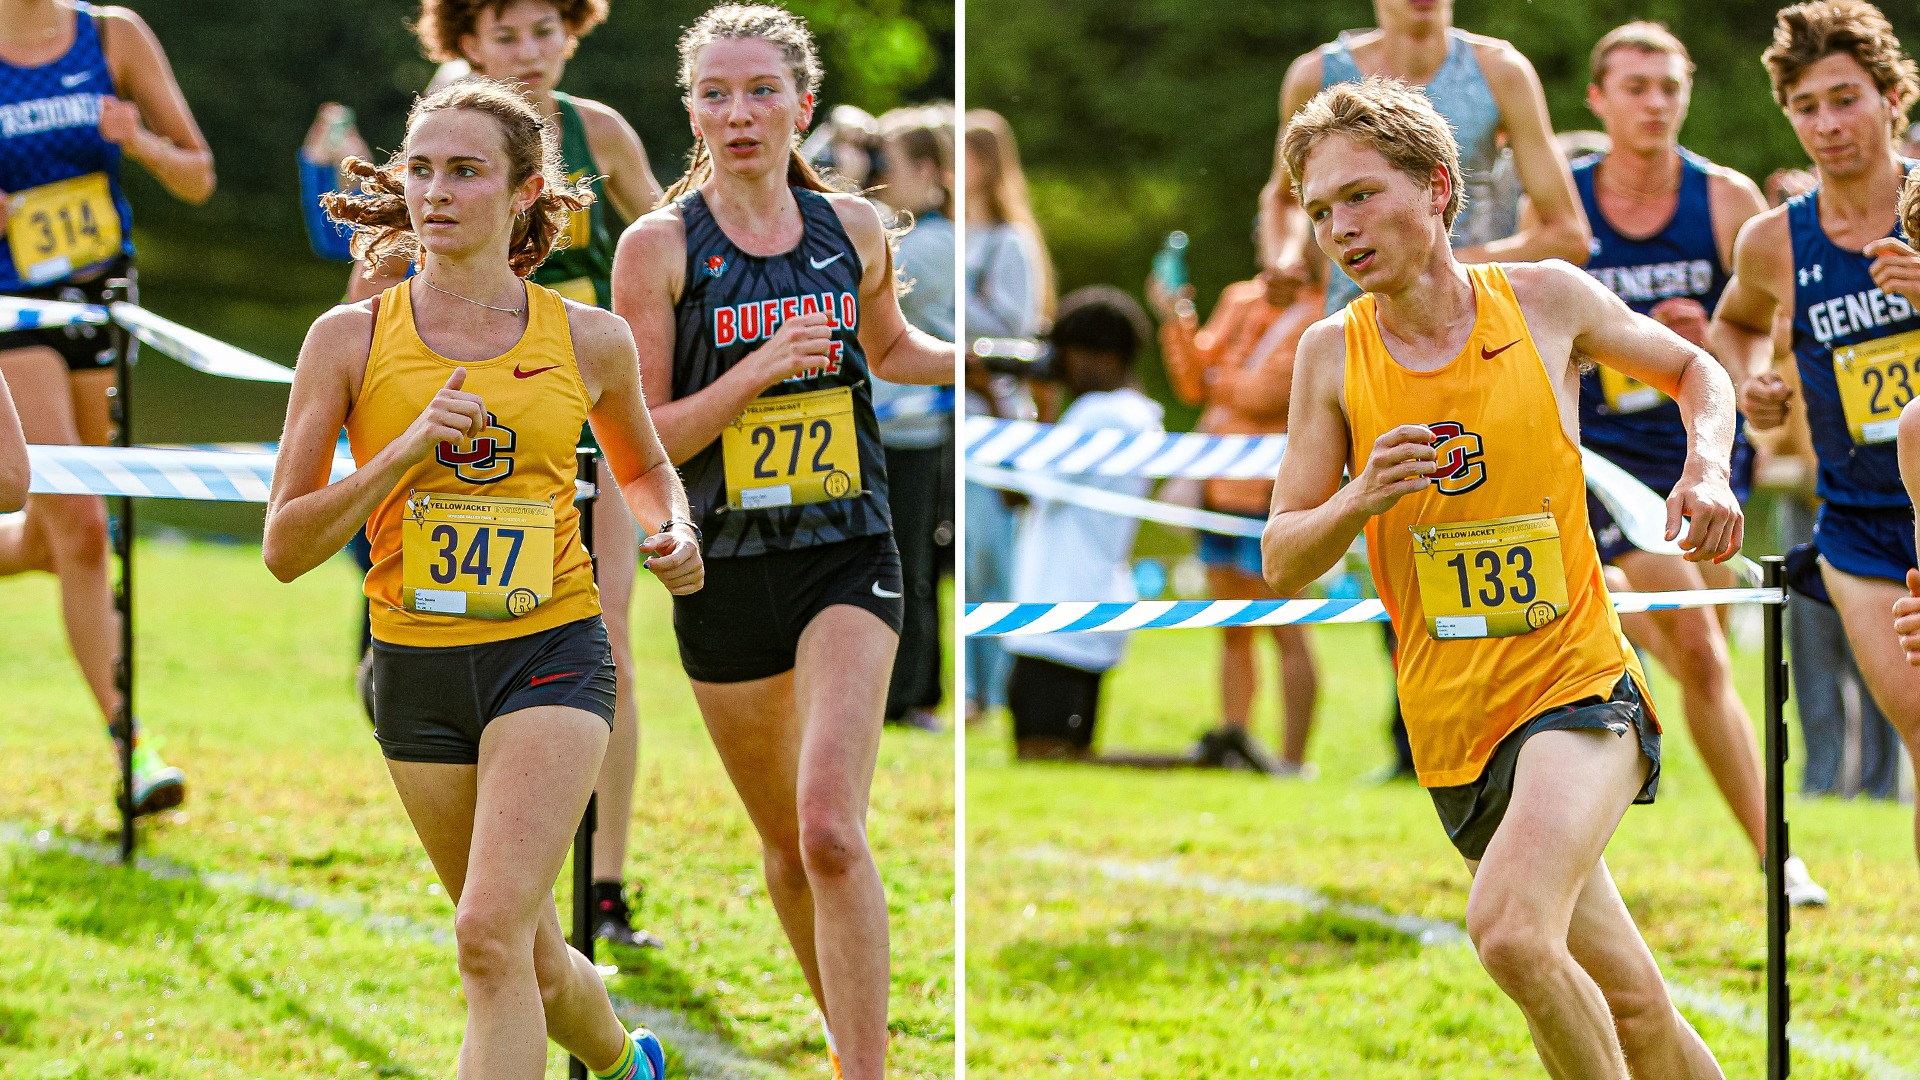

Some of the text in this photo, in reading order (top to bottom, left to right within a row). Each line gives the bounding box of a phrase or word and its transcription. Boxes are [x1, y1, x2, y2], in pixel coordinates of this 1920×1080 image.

[31, 200, 98, 254] 314
[1588, 259, 1713, 301] ENESEO
[1808, 286, 1919, 343] GENES
[751, 419, 835, 479] 272
[430, 502, 492, 512] YELLOWJACKET
[430, 525, 525, 587] 347
[1447, 545, 1537, 608] 133
